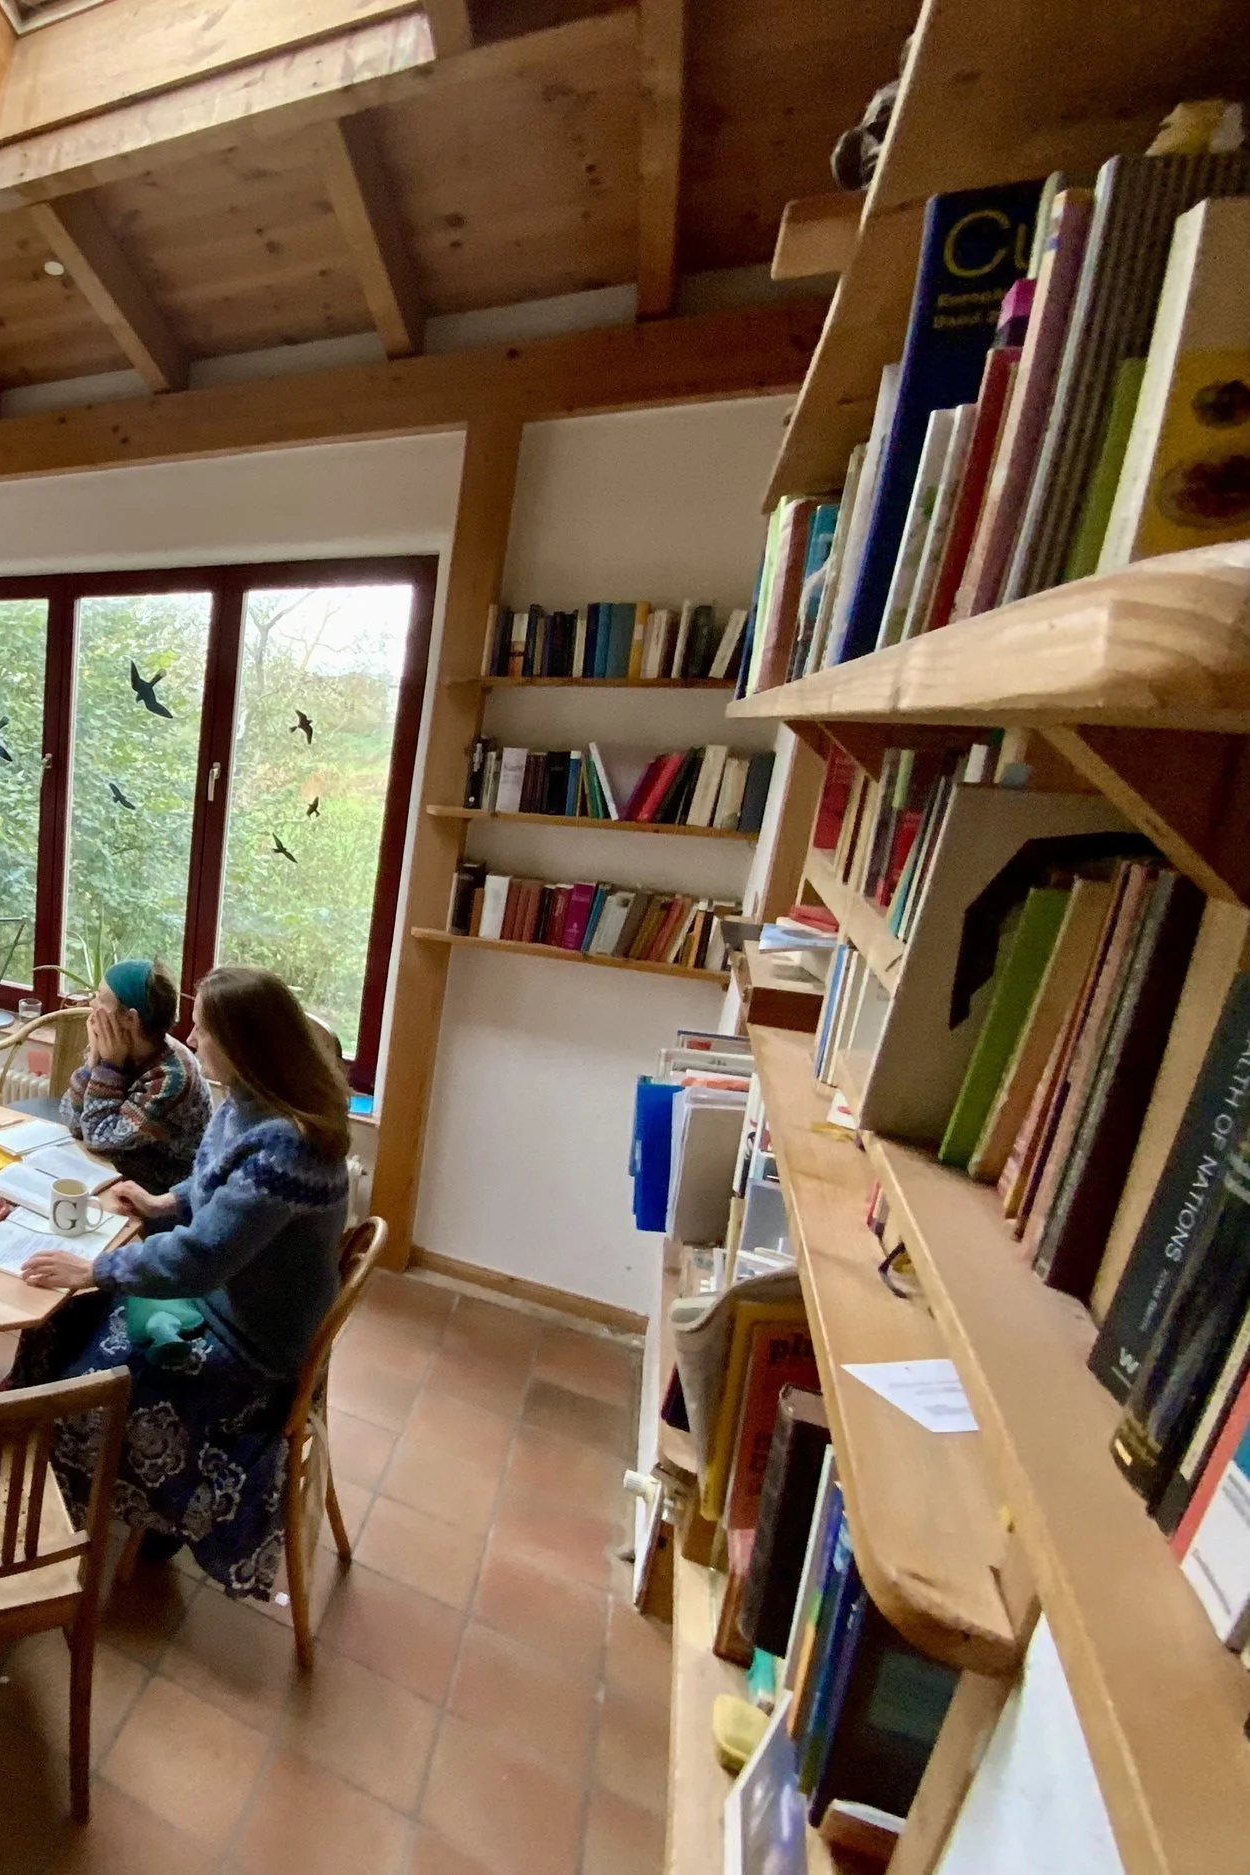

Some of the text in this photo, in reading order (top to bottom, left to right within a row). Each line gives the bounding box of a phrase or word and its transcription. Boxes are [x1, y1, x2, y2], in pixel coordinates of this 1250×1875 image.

[1211, 1113, 1233, 1151] OF
[53, 1199, 79, 1231] G
[1165, 1153, 1218, 1263] NATIONS
